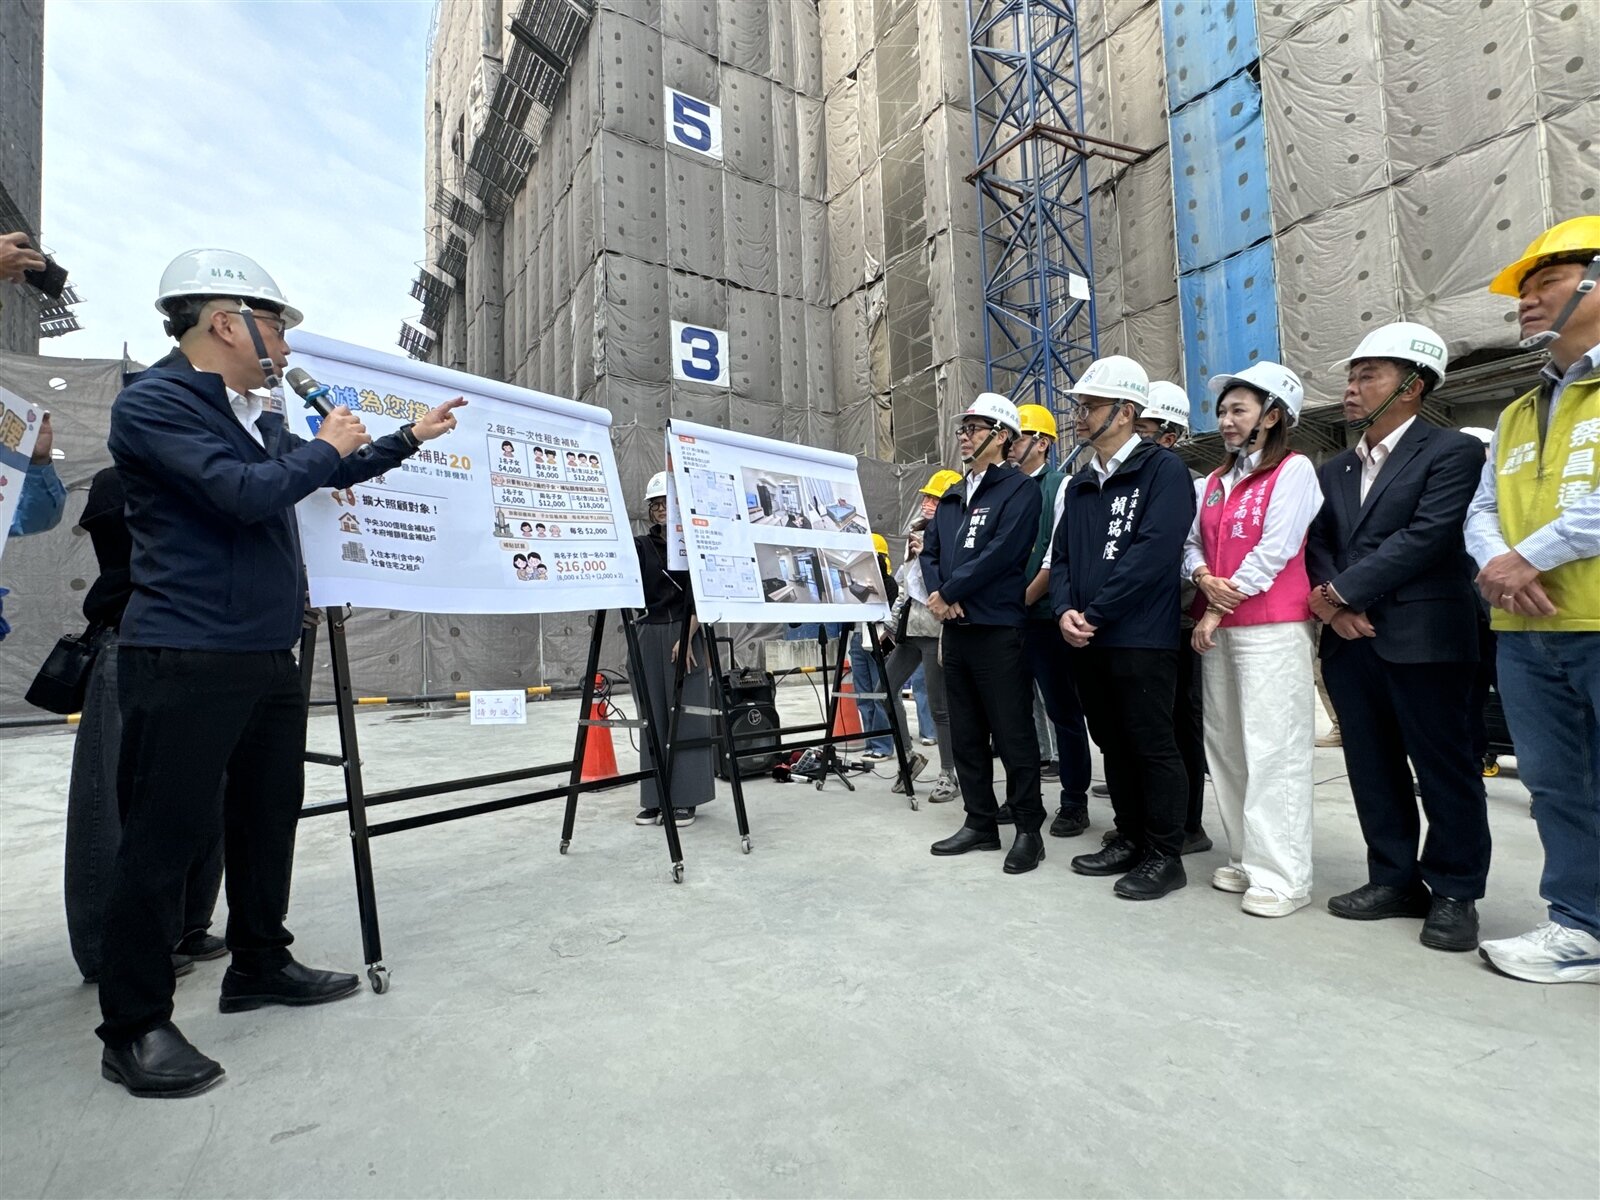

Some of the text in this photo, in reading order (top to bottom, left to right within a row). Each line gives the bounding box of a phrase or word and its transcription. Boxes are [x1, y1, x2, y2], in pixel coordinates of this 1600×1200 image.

[673, 91, 711, 152] 5
[211, 268, 247, 281] 副局長
[681, 326, 720, 383] 3
[487, 423, 580, 449] 2.每年一次性租金補貼
[408, 449, 472, 471] 補貼2.0
[498, 464, 522, 474] $4,000
[536, 471, 560, 480] $8,000
[573, 474, 600, 483] $12,000
[503, 488, 524, 497] 1名子女
[540, 492, 562, 500] 兩名子女
[502, 495, 526, 505] $6,000
[539, 499, 566, 508] $12,000
[578, 502, 605, 510] $18,000
[1124, 488, 1140, 533] 立法委員
[364, 517, 436, 533] 中央300億租金補貼戶
[570, 527, 608, 535] 每名 $2,000
[1102, 496, 1128, 560] 賴瑞隆
[370, 549, 425, 564] 入住本市(含中央)
[371, 559, 420, 572] 社會住宅之租戶
[556, 560, 607, 573] $16,000
